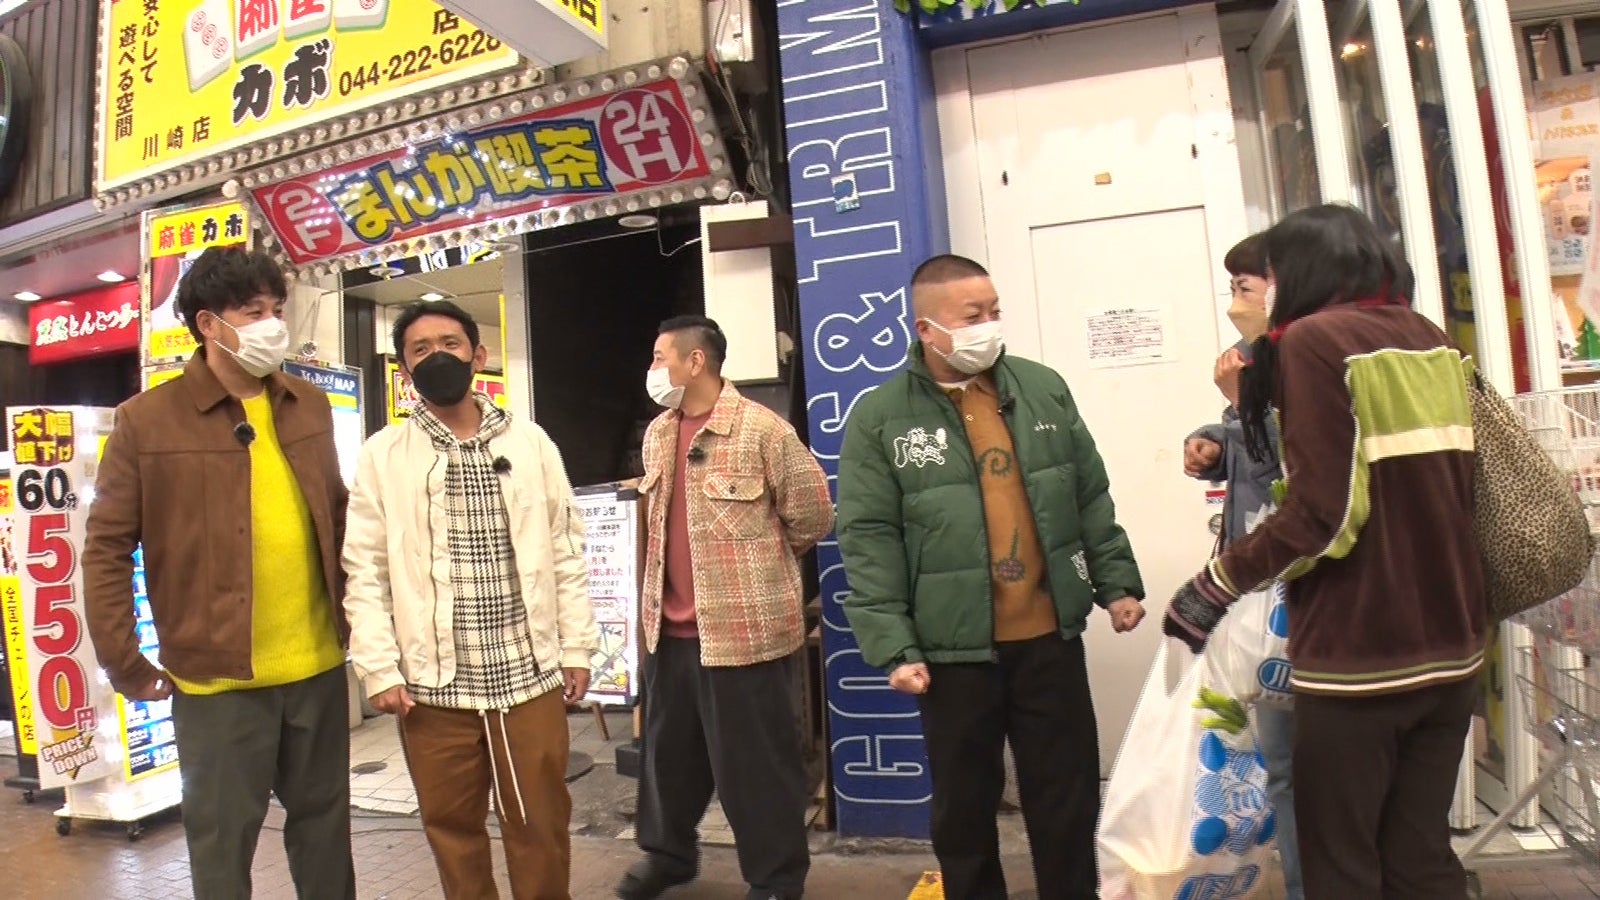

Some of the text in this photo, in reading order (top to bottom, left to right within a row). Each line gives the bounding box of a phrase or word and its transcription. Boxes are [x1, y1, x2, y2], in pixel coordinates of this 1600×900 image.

[115, 23, 138, 141] 遊べる空間
[232, 38, 331, 124] カボ
[142, 116, 211, 160] 川崎店
[340, 126, 602, 238] まんが喫茶
[814, 287, 911, 373] &
[334, 378, 355, 392] MAP
[15, 413, 72, 437] 大幅
[42, 736, 86, 761] PRICE
[53, 749, 98, 775] DOWN
